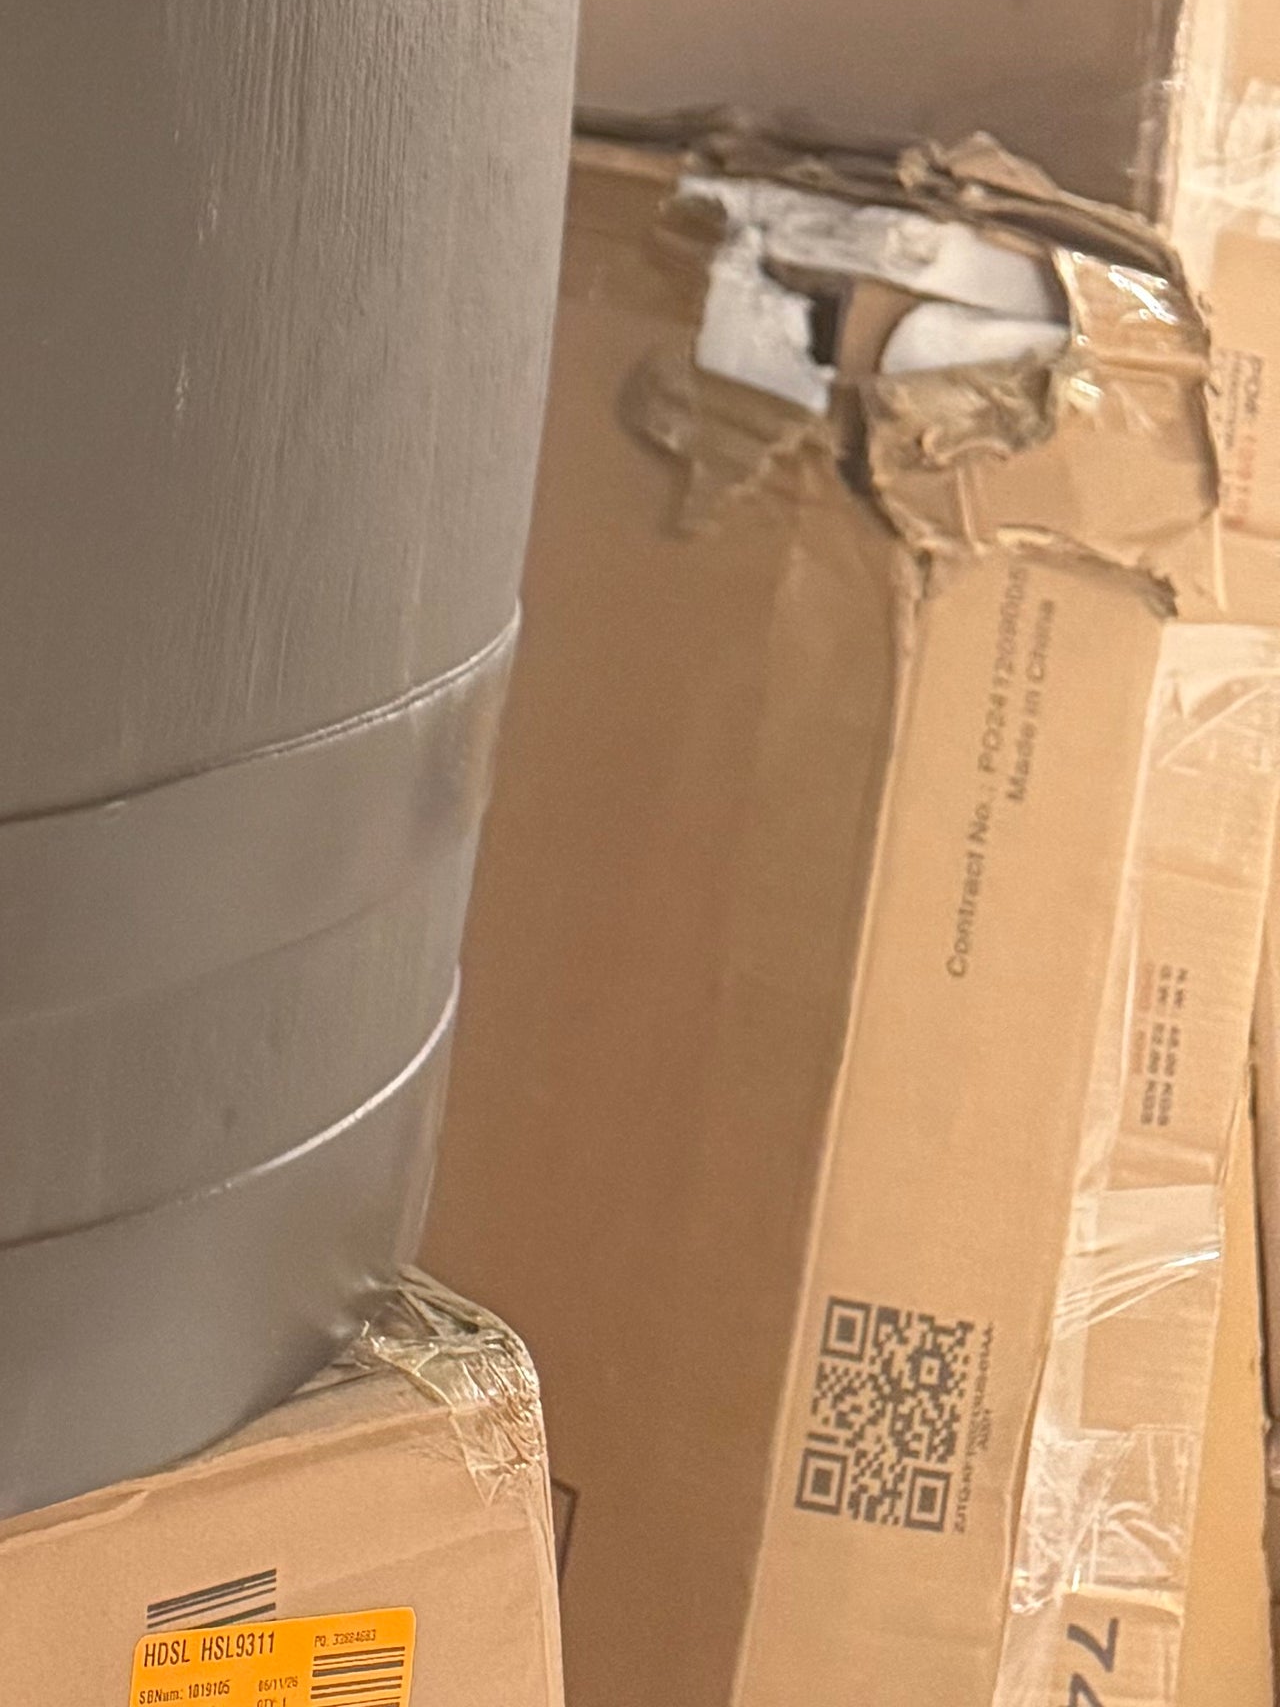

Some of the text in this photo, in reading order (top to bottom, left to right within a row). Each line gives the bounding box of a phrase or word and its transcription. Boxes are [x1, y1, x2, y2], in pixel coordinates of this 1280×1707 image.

[1006, 599, 1055, 800] Made in China
[945, 851, 985, 978] Contract
[144, 1631, 275, 1667] HDSL HSL9311
[139, 1679, 231, 1704] SBNum: 1019105
